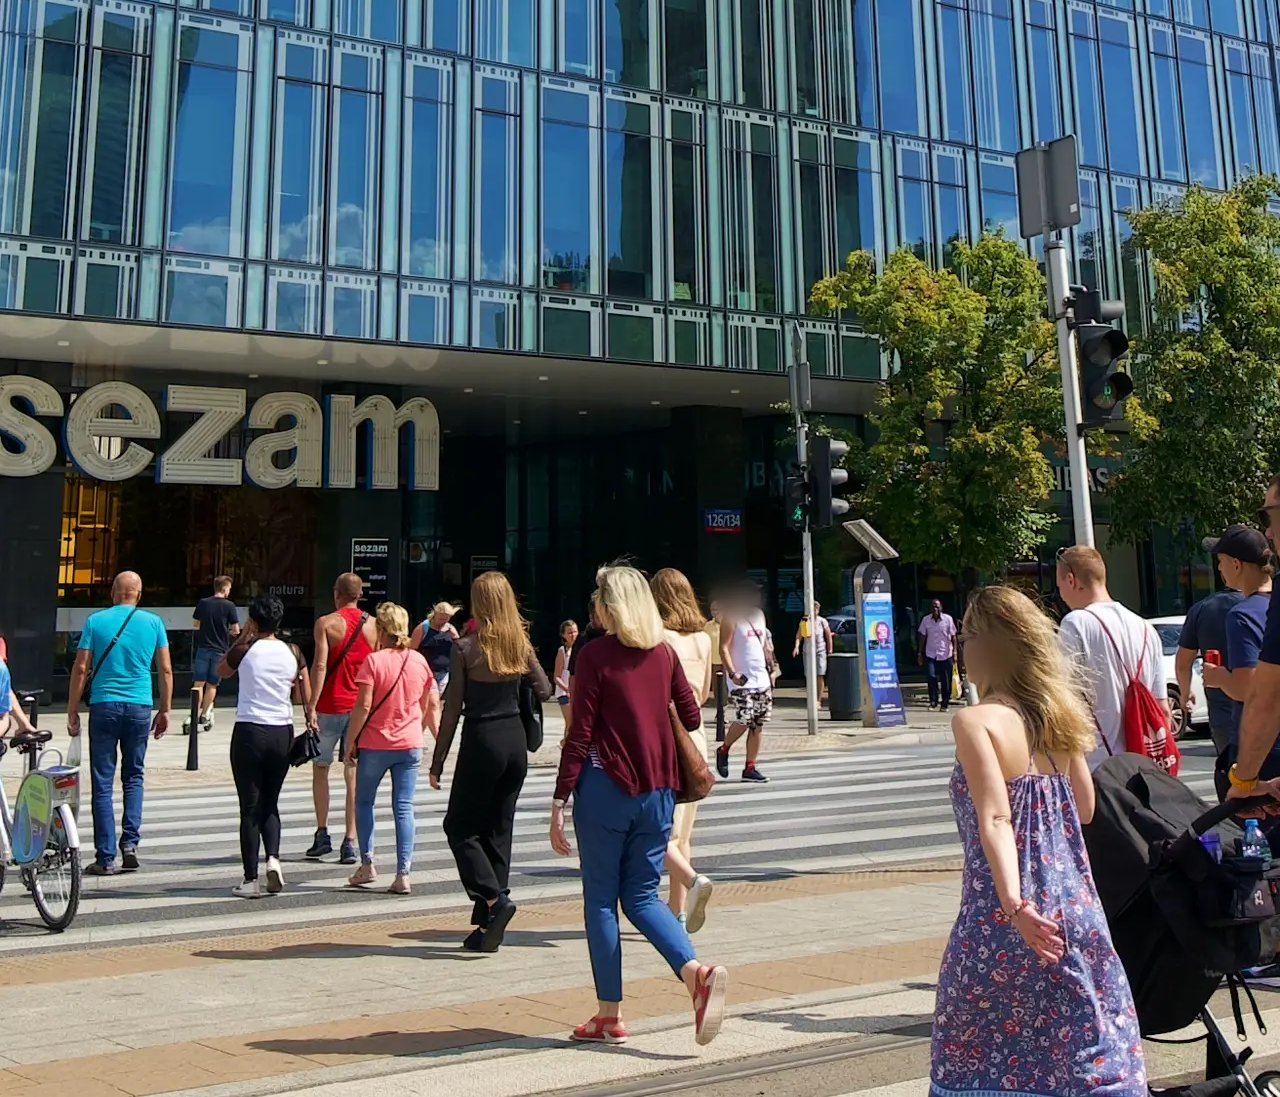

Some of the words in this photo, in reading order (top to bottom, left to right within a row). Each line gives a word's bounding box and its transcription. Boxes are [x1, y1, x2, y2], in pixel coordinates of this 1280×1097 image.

[707, 513, 741, 528] 126/134
[354, 544, 388, 553] sezam
[269, 584, 304, 595] natura
